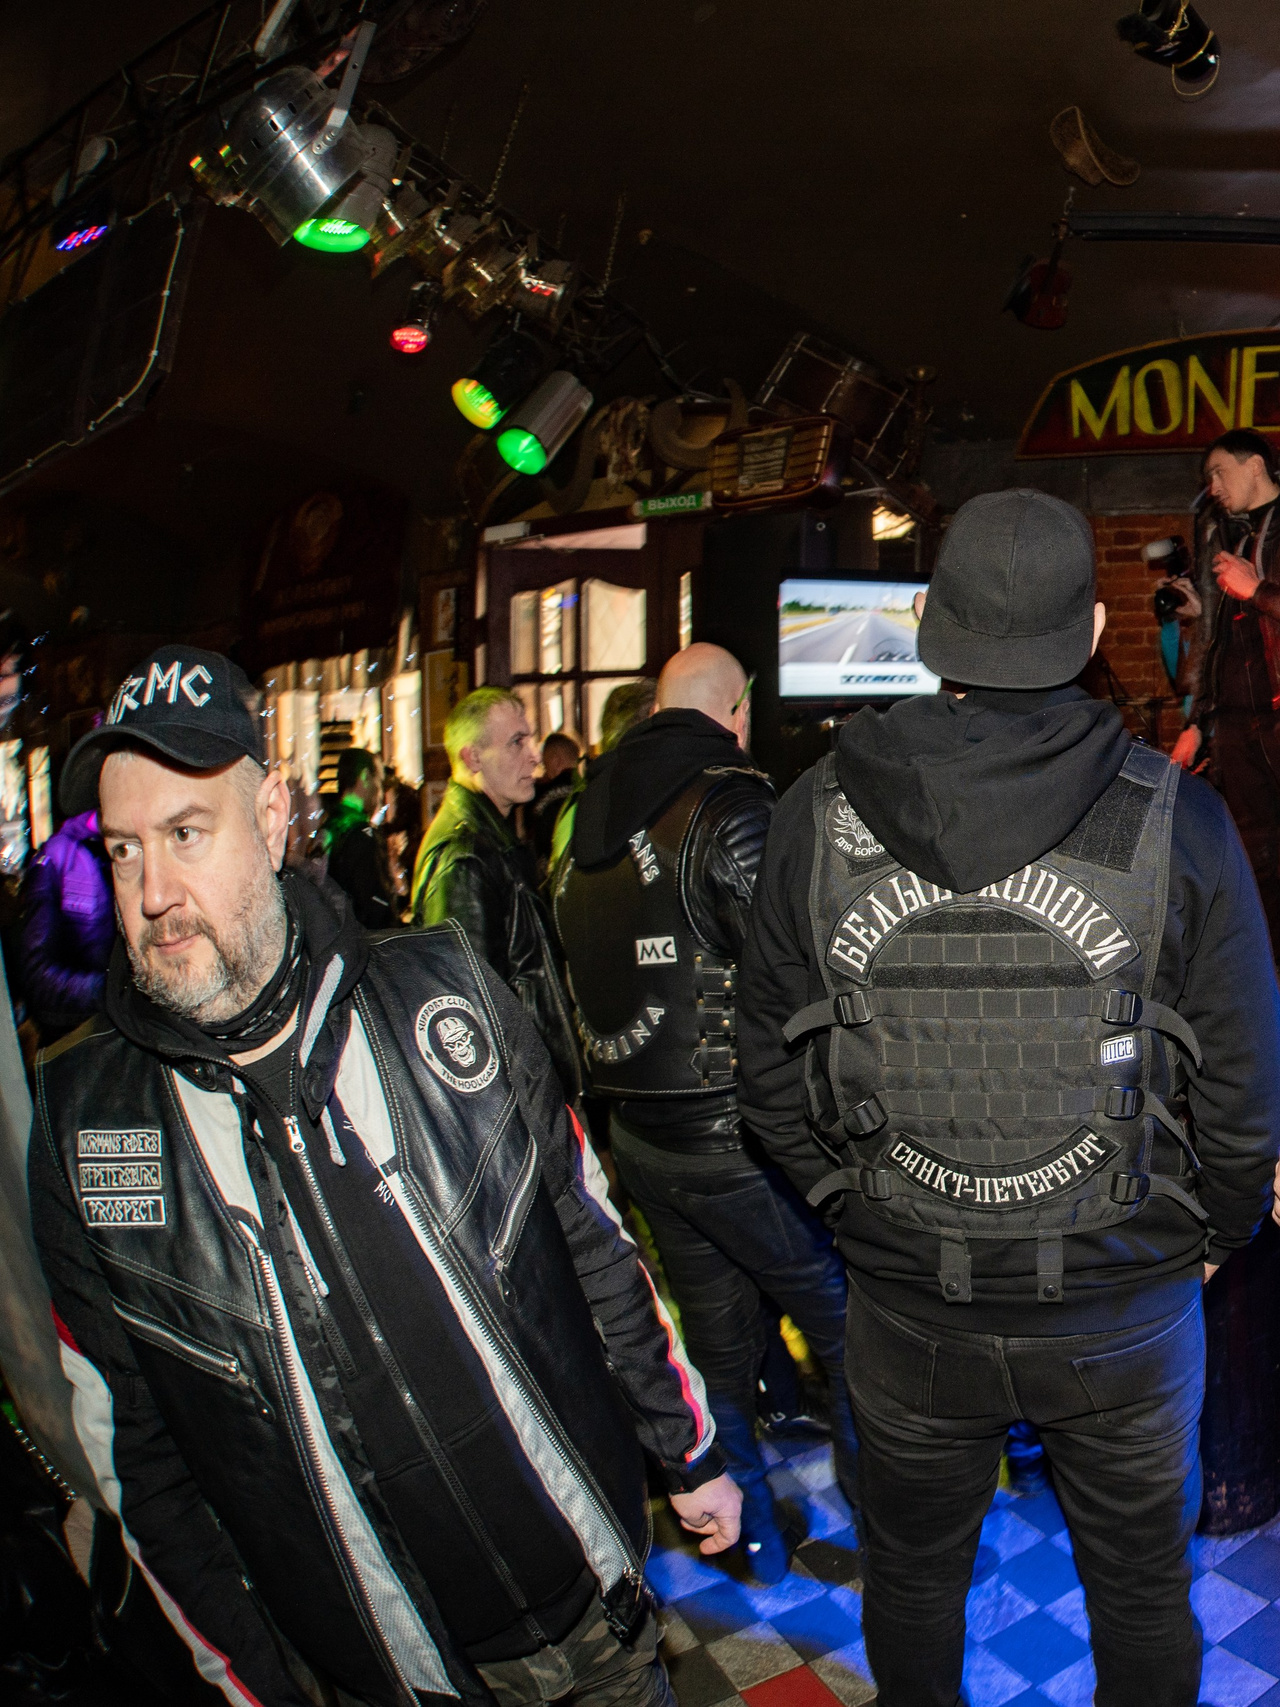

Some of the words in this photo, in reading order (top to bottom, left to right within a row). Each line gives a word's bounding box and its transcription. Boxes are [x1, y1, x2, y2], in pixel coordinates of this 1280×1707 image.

[647, 494, 697, 511] ВЫХОД
[627, 829, 662, 883] ANS
[834, 836, 854, 854] ДЛЯ
[854, 843, 887, 857] БОРО
[831, 870, 953, 974] БЕЛЫ
[976, 864, 1132, 970] ОДОКИ
[640, 942, 675, 960] MC
[418, 998, 445, 1032] SUPPORT
[446, 997, 471, 1010] CLUB
[441, 1068, 458, 1086] THE
[889, 1132, 1106, 1203] САНКТ-ПЕТЕРБУРГ
[88, 1200, 156, 1222] PROSPECT
